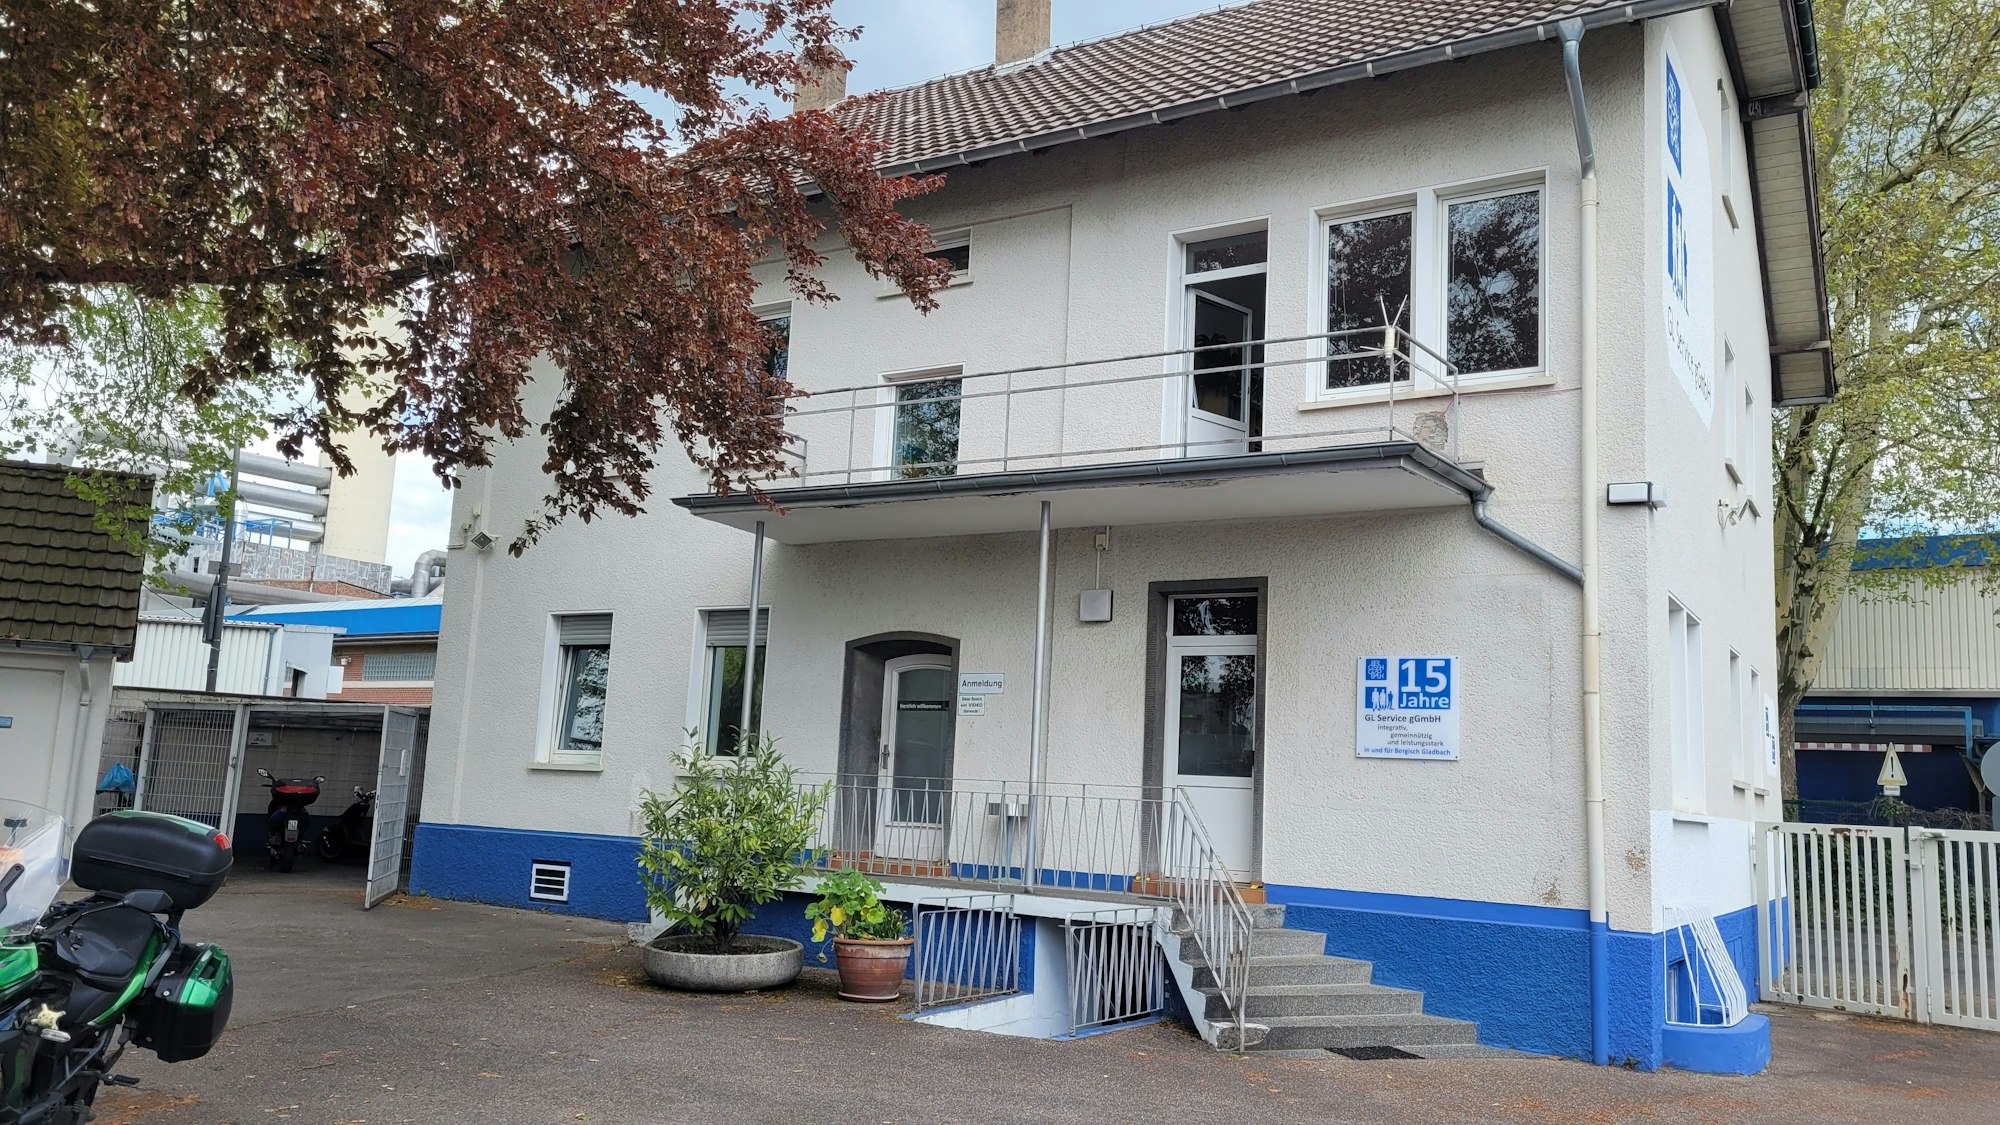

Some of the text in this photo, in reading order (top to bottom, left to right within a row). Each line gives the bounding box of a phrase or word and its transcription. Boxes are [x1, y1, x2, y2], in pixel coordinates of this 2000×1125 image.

[1401, 660, 1447, 693] 15
[962, 680, 1002, 688] Anmeldung
[1400, 692, 1449, 708] Jahre
[1364, 714, 1441, 724] GL Service gGmbH
[1390, 732, 1433, 740] gemeinnützig
[1421, 748, 1451, 756] Gladbach
